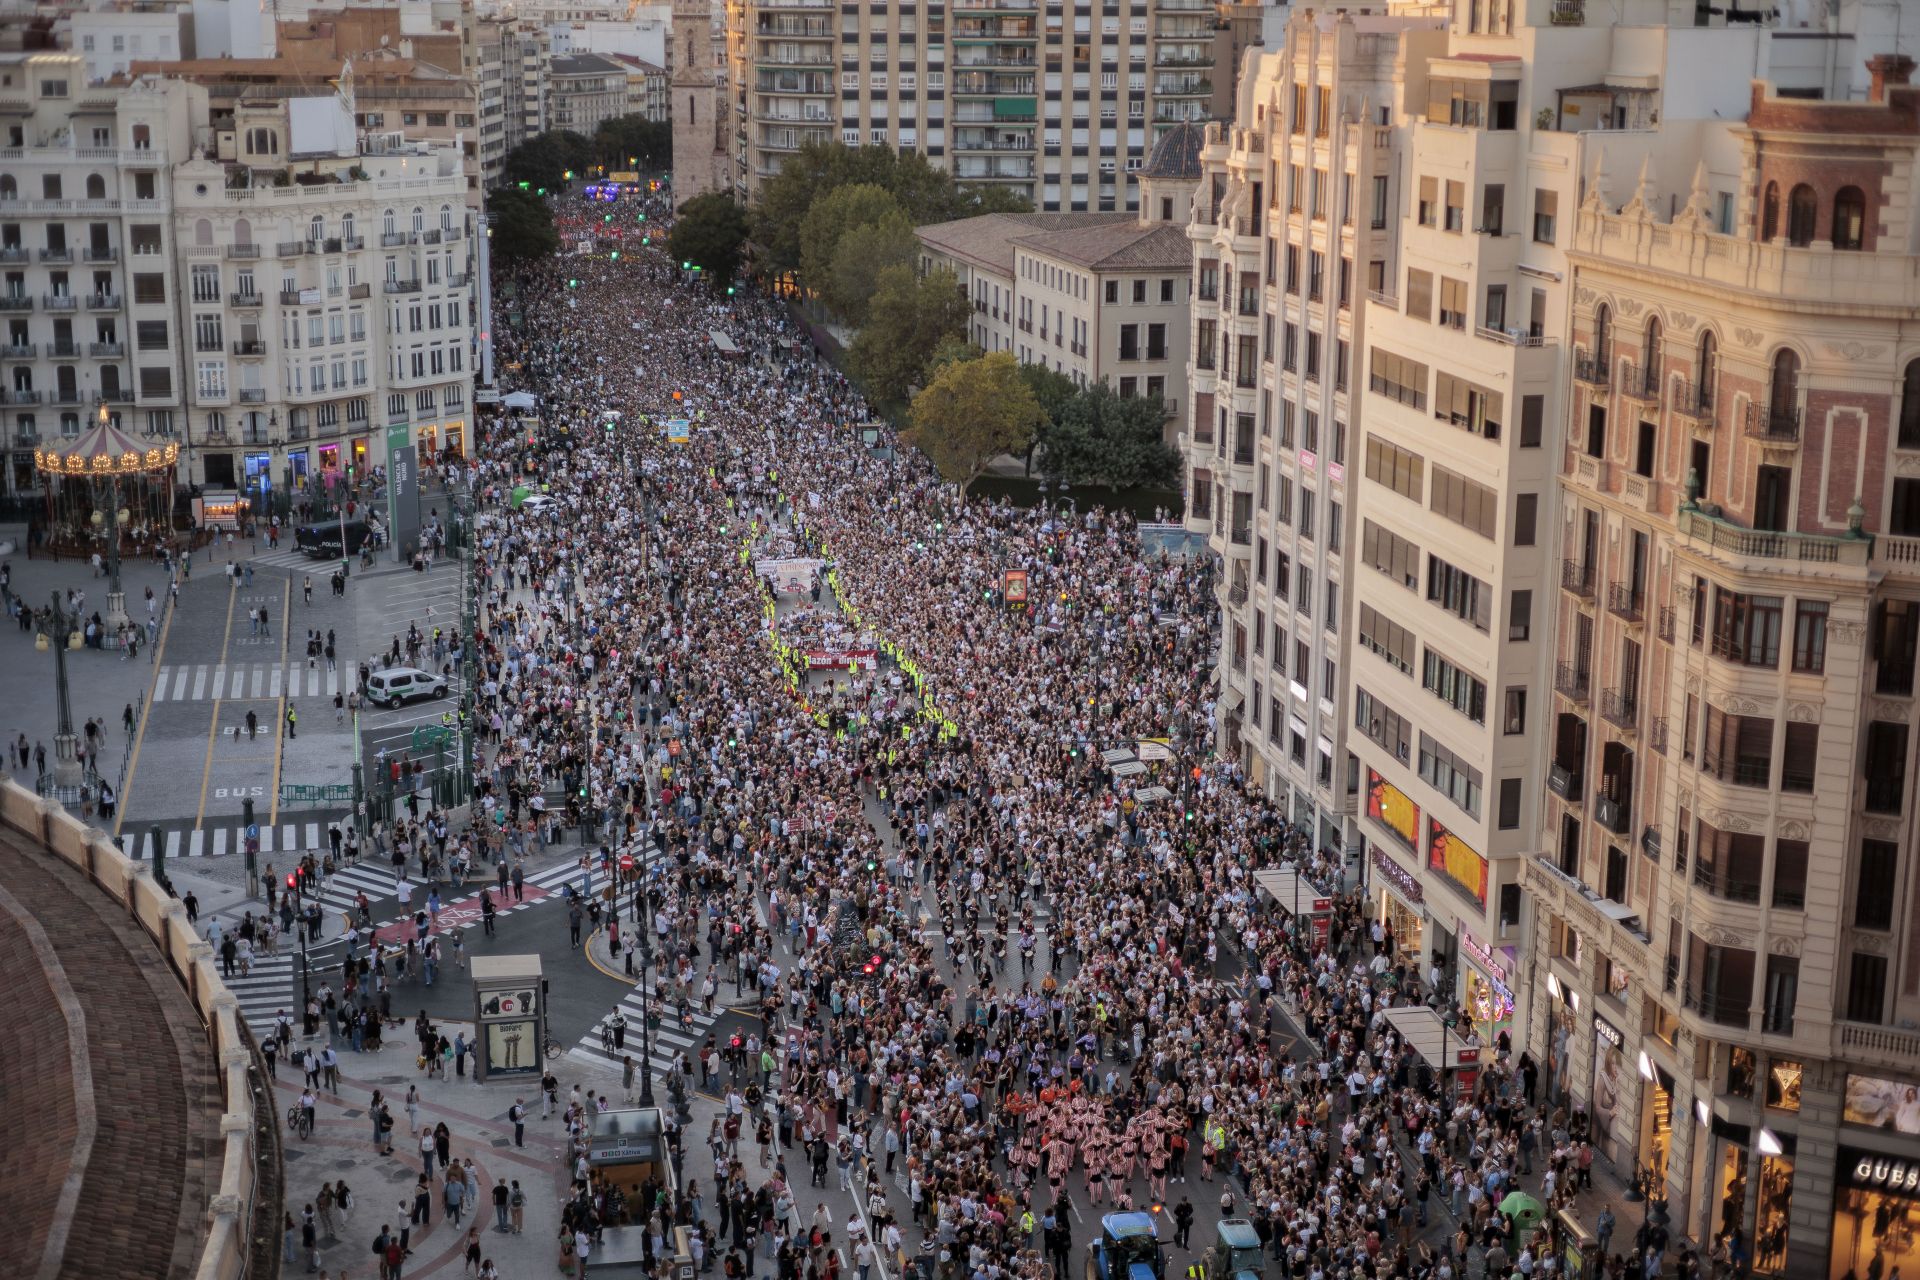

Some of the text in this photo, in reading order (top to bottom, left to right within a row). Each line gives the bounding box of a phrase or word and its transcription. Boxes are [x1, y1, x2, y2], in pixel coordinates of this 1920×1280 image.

[395, 463, 403, 496] VALENCIA
[223, 725, 269, 735] BUS
[215, 786, 263, 798] BUS
[1463, 934, 1504, 981] American
[1596, 1019, 1619, 1045] GUESS
[1857, 1163, 1917, 1186] GUES
